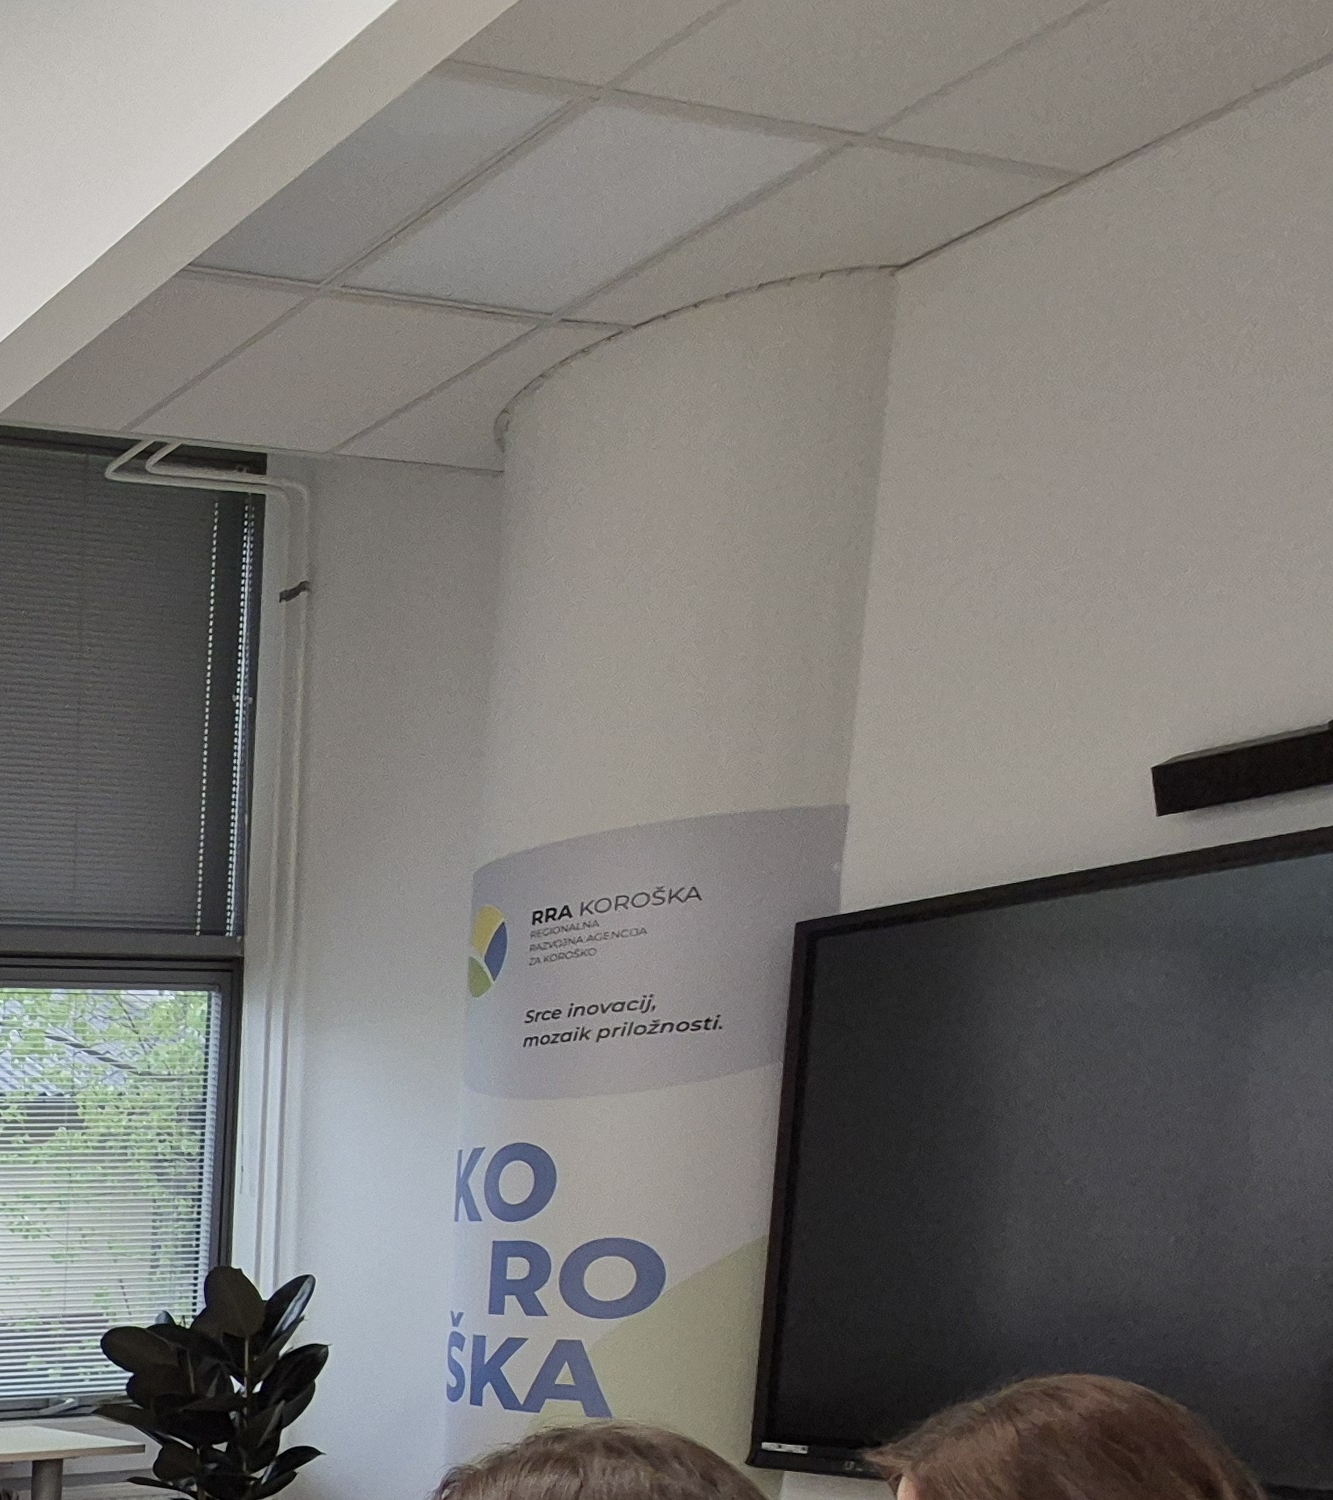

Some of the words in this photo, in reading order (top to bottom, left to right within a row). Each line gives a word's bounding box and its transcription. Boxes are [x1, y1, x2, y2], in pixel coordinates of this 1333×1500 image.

[531, 905, 573, 925] RRA
[579, 886, 703, 916] KOROŠKA
[522, 1026, 592, 1047] mozaik
[596, 1015, 723, 1042] priložnosti.
[524, 1009, 562, 1023] Srce
[567, 994, 656, 1018] inovacij,
[454, 1142, 557, 1222] KO
[488, 1237, 666, 1319] RO
[446, 1310, 613, 1418] ŠKA
